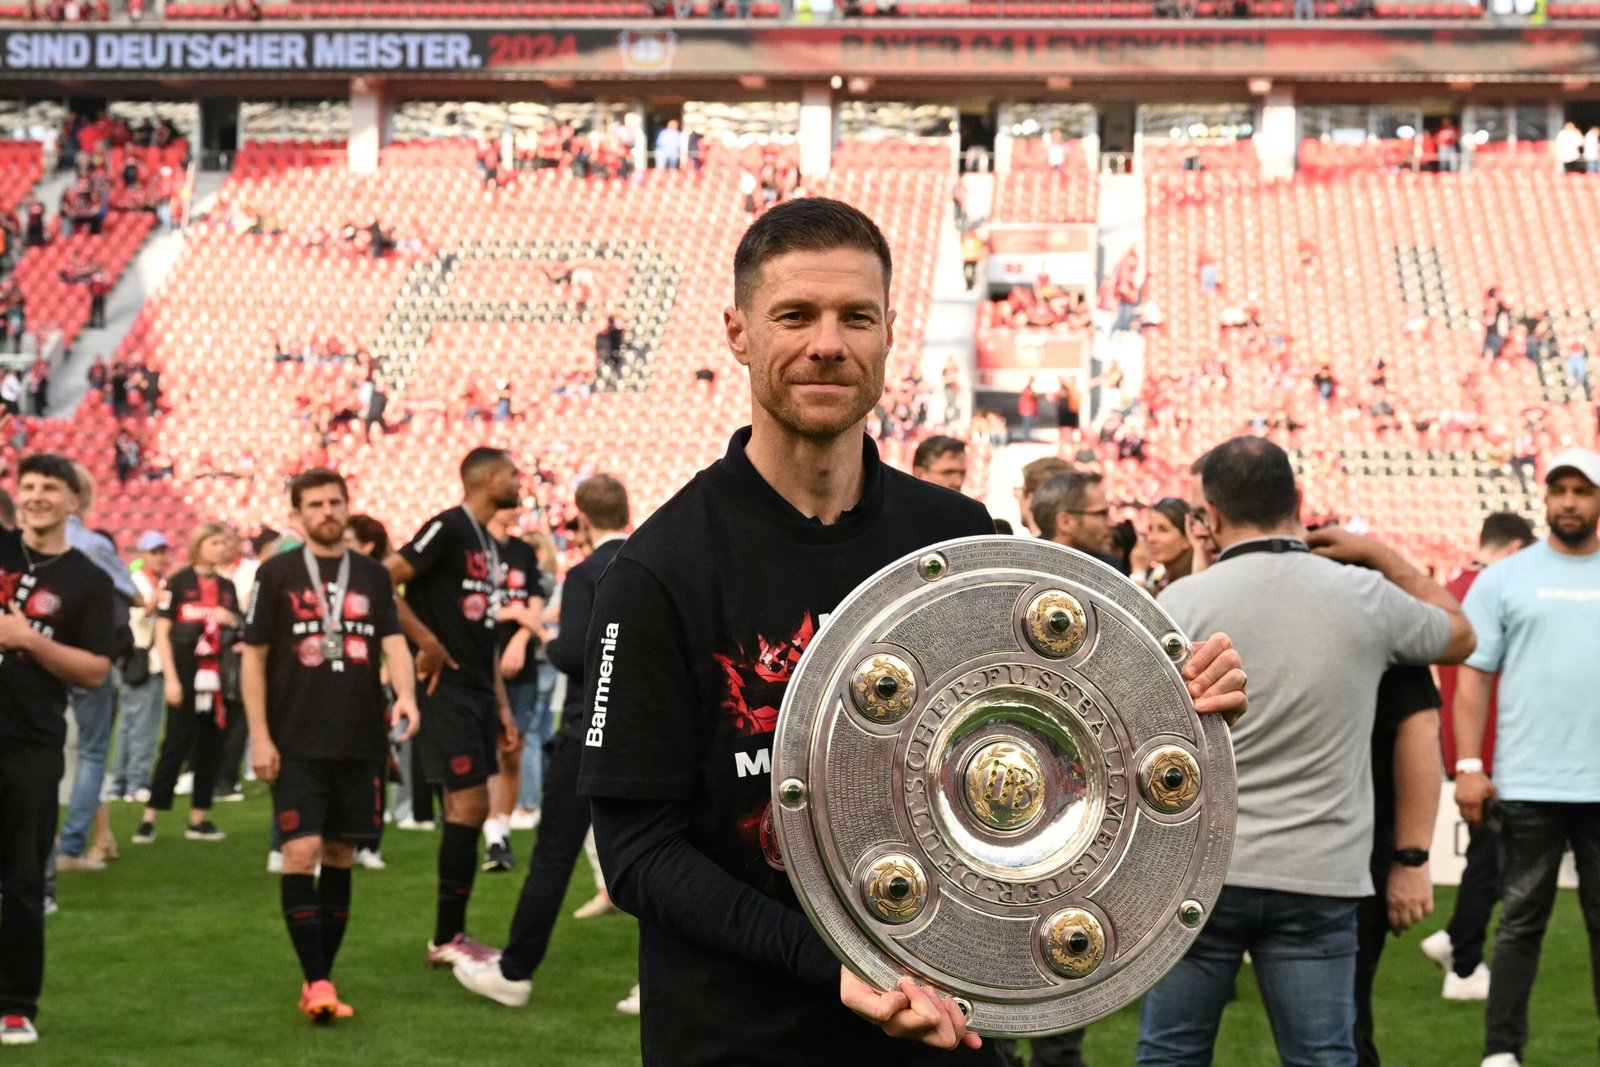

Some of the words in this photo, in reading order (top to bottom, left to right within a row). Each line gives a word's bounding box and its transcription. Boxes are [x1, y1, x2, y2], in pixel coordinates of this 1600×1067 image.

[6, 33, 90, 68] SIND
[96, 33, 308, 68] DEUTSCHER
[313, 33, 482, 68] MEISTER.
[487, 34, 578, 66] 2024
[841, 33, 962, 67] BAYER
[970, 33, 1014, 67] 04
[1025, 33, 1267, 67] LEVERKUSEN
[585, 622, 620, 748] Barmenia
[1004, 1022, 1027, 1031] BAYERN
